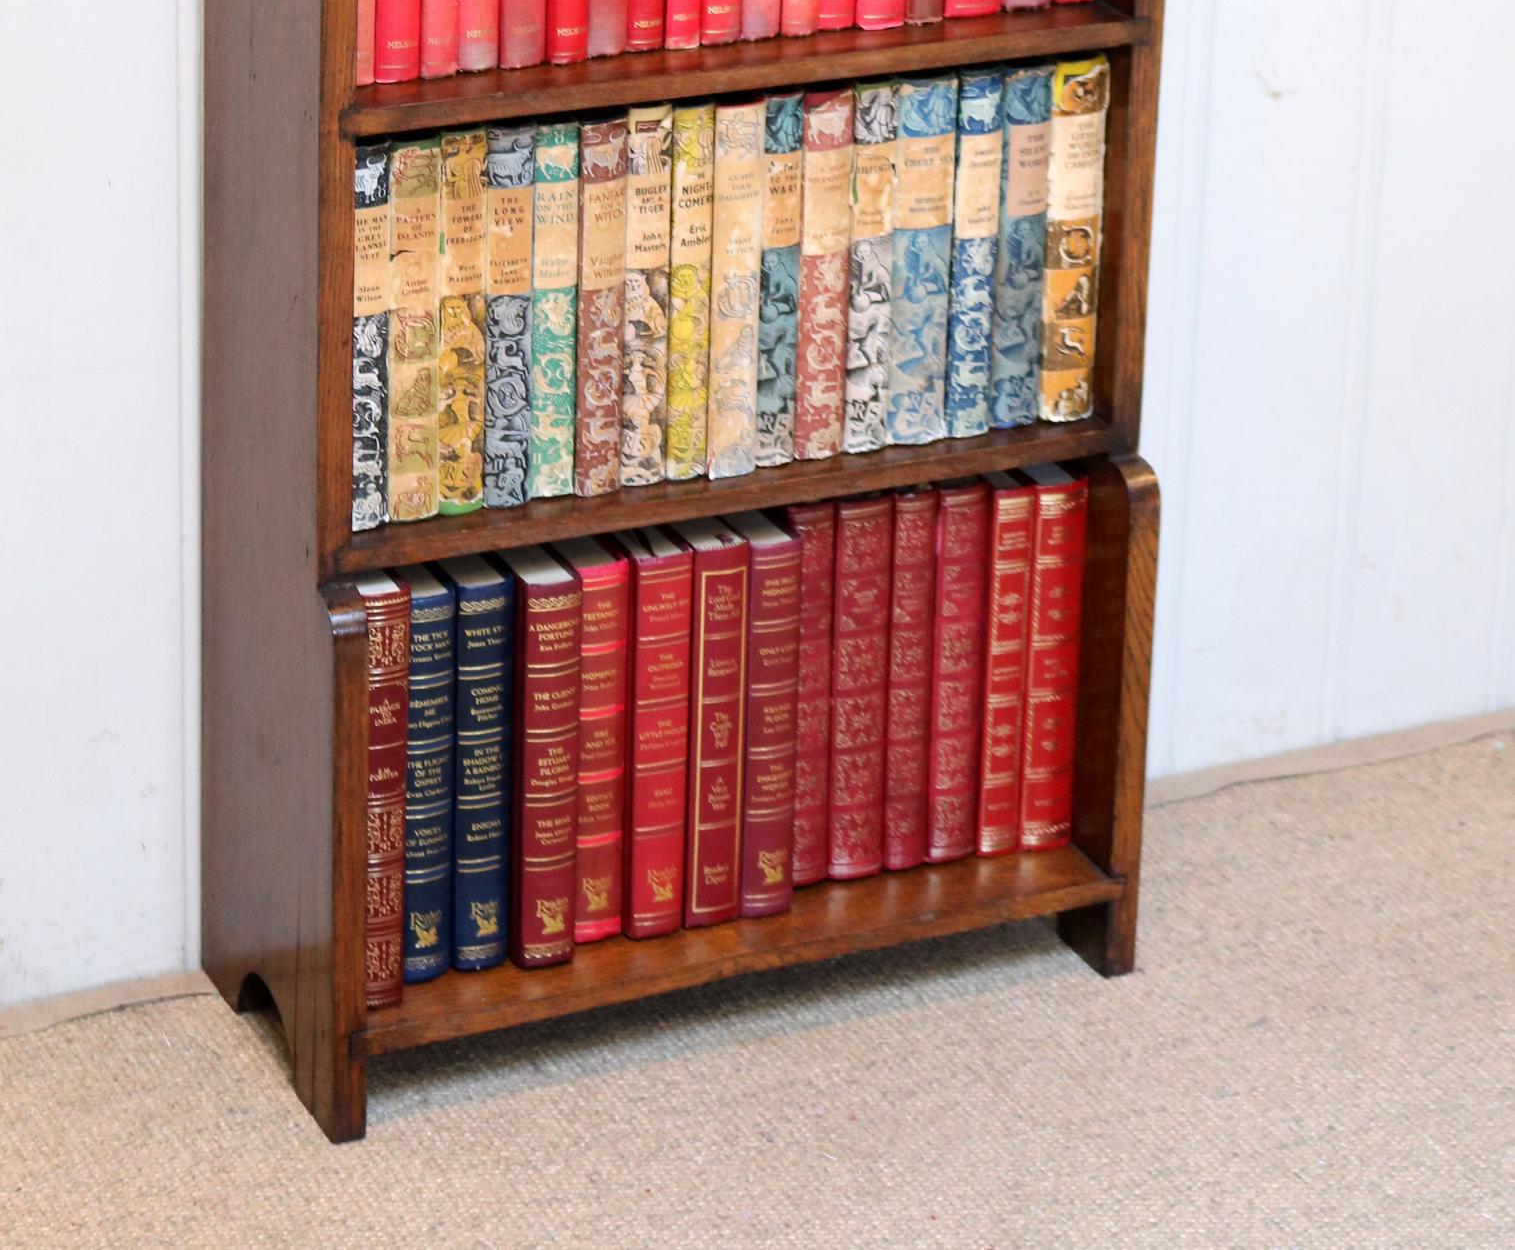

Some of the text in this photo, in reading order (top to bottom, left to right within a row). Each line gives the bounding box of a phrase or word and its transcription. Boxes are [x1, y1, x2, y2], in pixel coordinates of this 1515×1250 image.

[635, 185, 668, 195] BUGLES
[682, 182, 712, 195] NIGHT-
[537, 190, 574, 201] RAIN
[494, 207, 525, 215] LONG
[537, 204, 549, 212] ON
[639, 205, 664, 214] TIGER
[396, 213, 436, 223] PATTERN
[494, 218, 523, 227] VIEW
[537, 213, 574, 224] WIND
[690, 224, 706, 234] Eric
[358, 234, 382, 242] GREY
[397, 231, 435, 241] ISLANDS
[642, 232, 662, 241] John
[465, 628, 491, 637] WHITE
